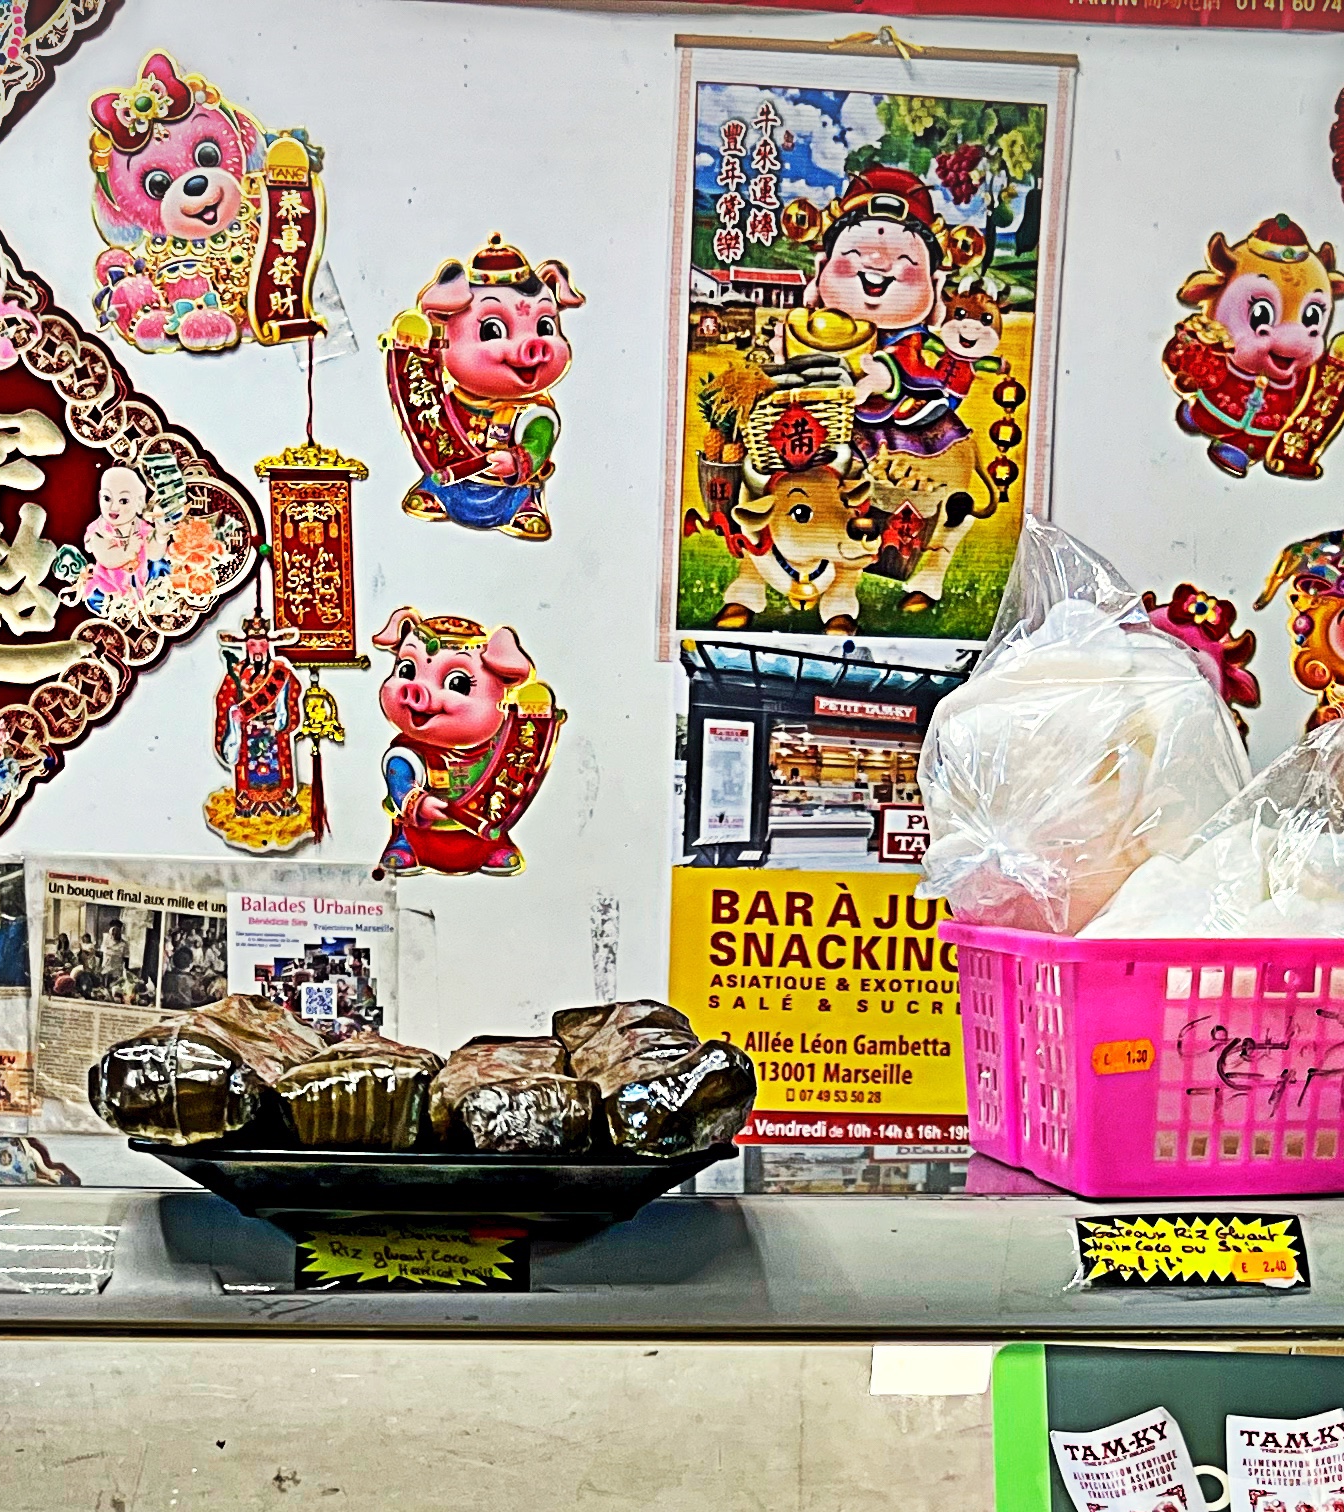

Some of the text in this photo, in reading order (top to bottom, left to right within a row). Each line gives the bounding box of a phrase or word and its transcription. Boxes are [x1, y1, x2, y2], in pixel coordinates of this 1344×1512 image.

[748, 102, 778, 244] 牛來運轉
[268, 189, 310, 318] 恭喜發財
[48, 883, 208, 910] Un bouquet final aux mille et
[240, 897, 383, 916] Balades Urbaines
[712, 882, 861, 928] BAR À
[355, 924, 394, 933] Marseille
[710, 974, 961, 994] ASIATIQUE & EXOTIQU
[708, 994, 832, 1012] SALÉ &
[745, 1032, 951, 1057] Allée Léon Gambetta
[758, 1061, 912, 1085] 13001 Marseille
[799, 1091, 814, 1101] 07
[834, 1091, 848, 1102] 53
[867, 1092, 881, 1104] 28
[755, 1119, 826, 1138] Vendredi
[829, 1125, 843, 1138] de
[1263, 1261, 1287, 1273] 2.40
[1064, 1421, 1168, 1462] TAM-KY
